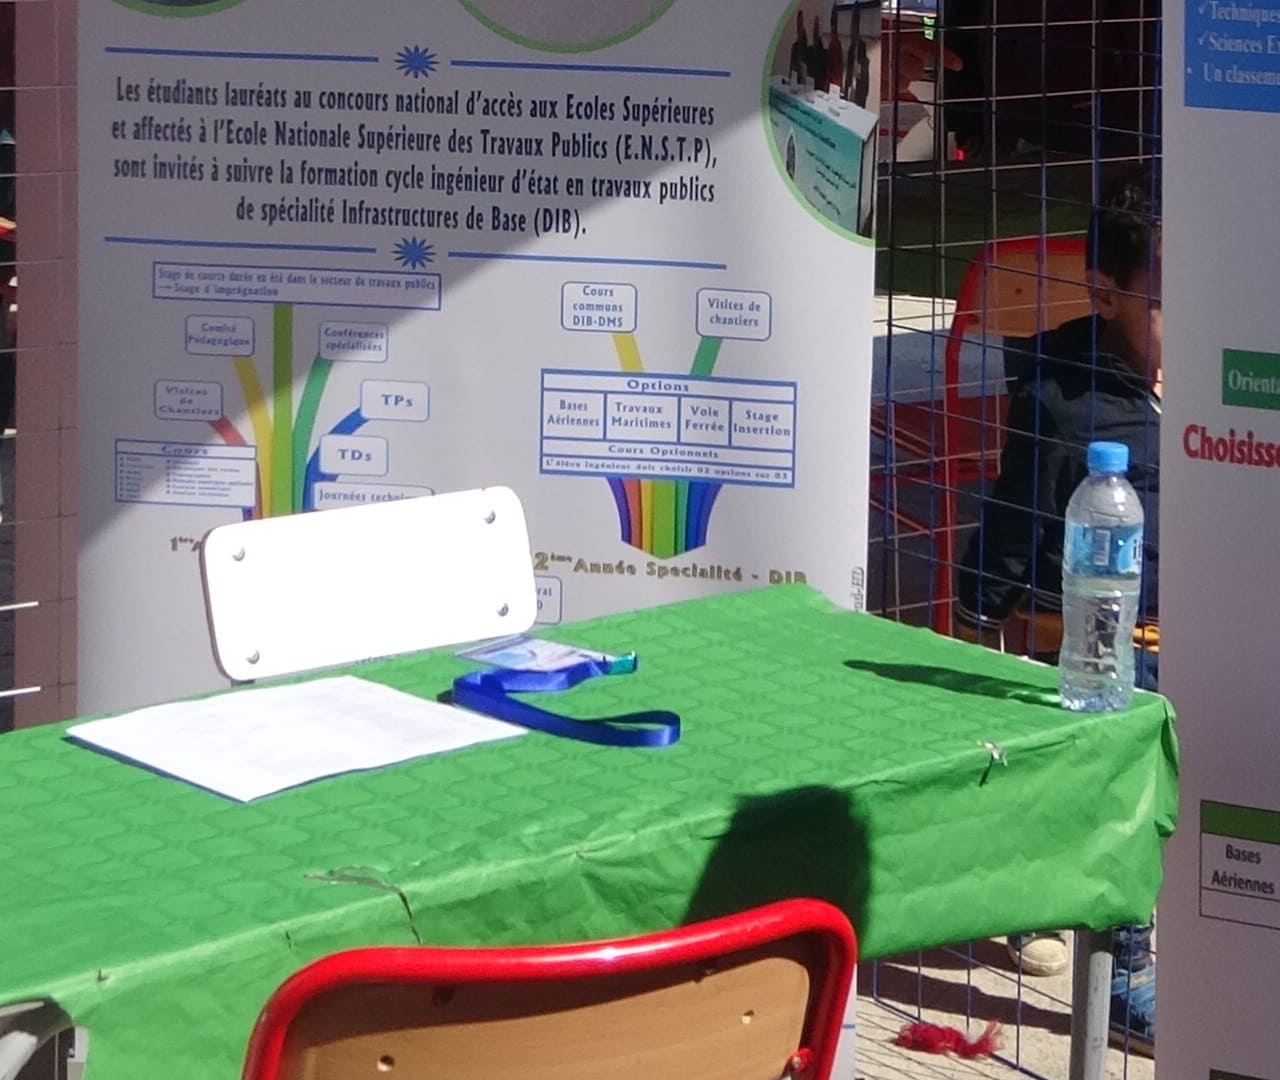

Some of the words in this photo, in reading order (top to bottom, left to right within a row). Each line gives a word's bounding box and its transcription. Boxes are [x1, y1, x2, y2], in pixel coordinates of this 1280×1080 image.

[117, 77, 140, 102] Les
[147, 78, 218, 106] étudiants
[225, 82, 286, 108] lauréats
[294, 89, 311, 109] au
[319, 90, 388, 111] concours
[396, 88, 459, 115] national
[530, 98, 558, 118] aux
[566, 93, 615, 121] Ecoles
[622, 96, 714, 129] Supérieures
[112, 120, 126, 139] et
[133, 117, 192, 142] affectés
[199, 120, 207, 143] à
[275, 121, 350, 148] Nationale
[358, 124, 441, 154] Supérieure
[448, 131, 472, 153] des
[481, 129, 543, 157] Travaux
[551, 132, 607, 159] Publics
[583, 286, 614, 297] Cours
[573, 301, 623, 312] communs
[708, 298, 745, 311] Visites
[749, 301, 761, 312] de
[710, 313, 759, 328] chantiers
[627, 379, 689, 392] Options
[381, 395, 413, 407] TPs
[338, 449, 371, 461] TDs
[1225, 844, 1262, 866] Bases
[1211, 868, 1275, 897] Aériennes
